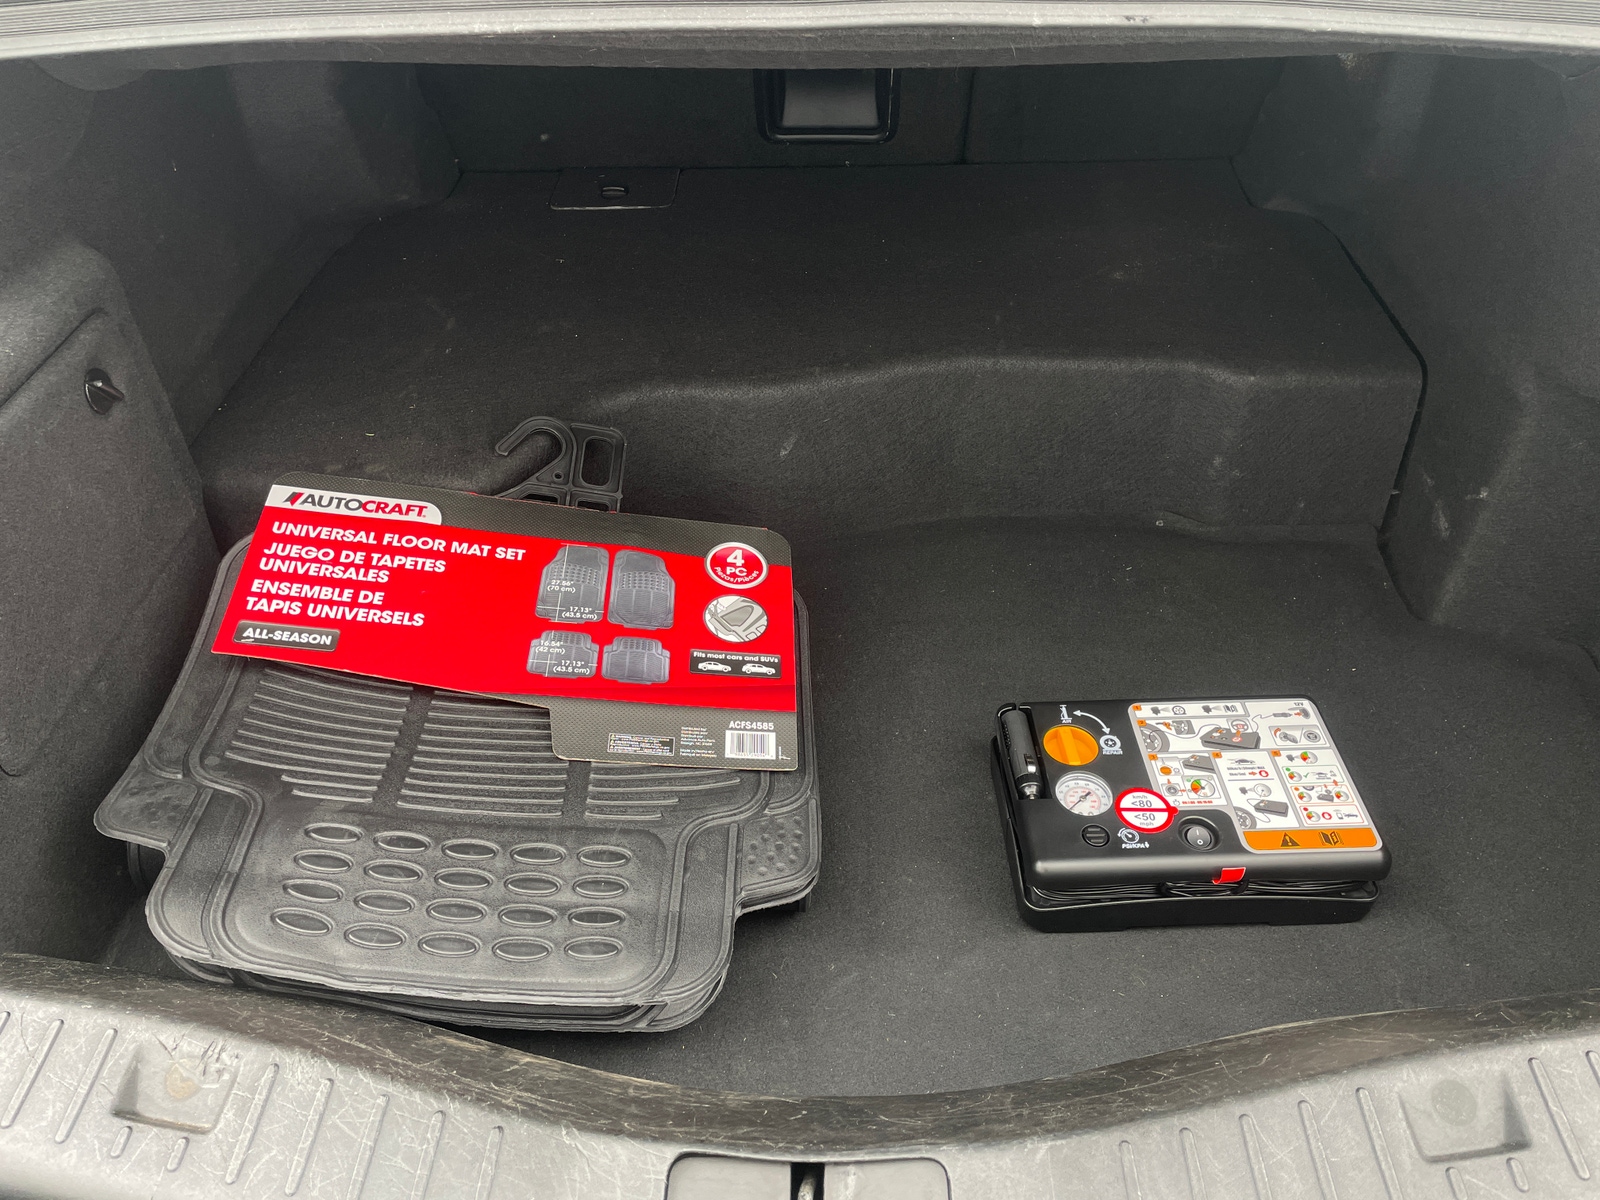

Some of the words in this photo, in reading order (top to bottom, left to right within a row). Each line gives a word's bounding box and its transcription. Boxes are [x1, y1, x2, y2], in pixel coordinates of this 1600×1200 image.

[299, 493, 428, 517] AUTOCRAFT
[272, 521, 378, 545] UNIVERSAL
[382, 532, 447, 552] FLOOR
[450, 541, 491, 556] MAT
[495, 547, 526, 561] SET
[259, 557, 390, 583] UNIVERSALES
[263, 542, 335, 562] JUEGO
[339, 551, 366, 565] DE
[371, 553, 446, 573] TAPETES
[726, 549, 744, 567] 4
[726, 566, 747, 576] PC
[251, 579, 354, 602] ENSEMBLE
[358, 590, 384, 605] DE
[246, 596, 302, 615] TAPIS
[307, 603, 425, 626] UNIVERSELS
[241, 627, 332, 645] ALL-SEASON
[729, 721, 774, 730] ACFS4585
